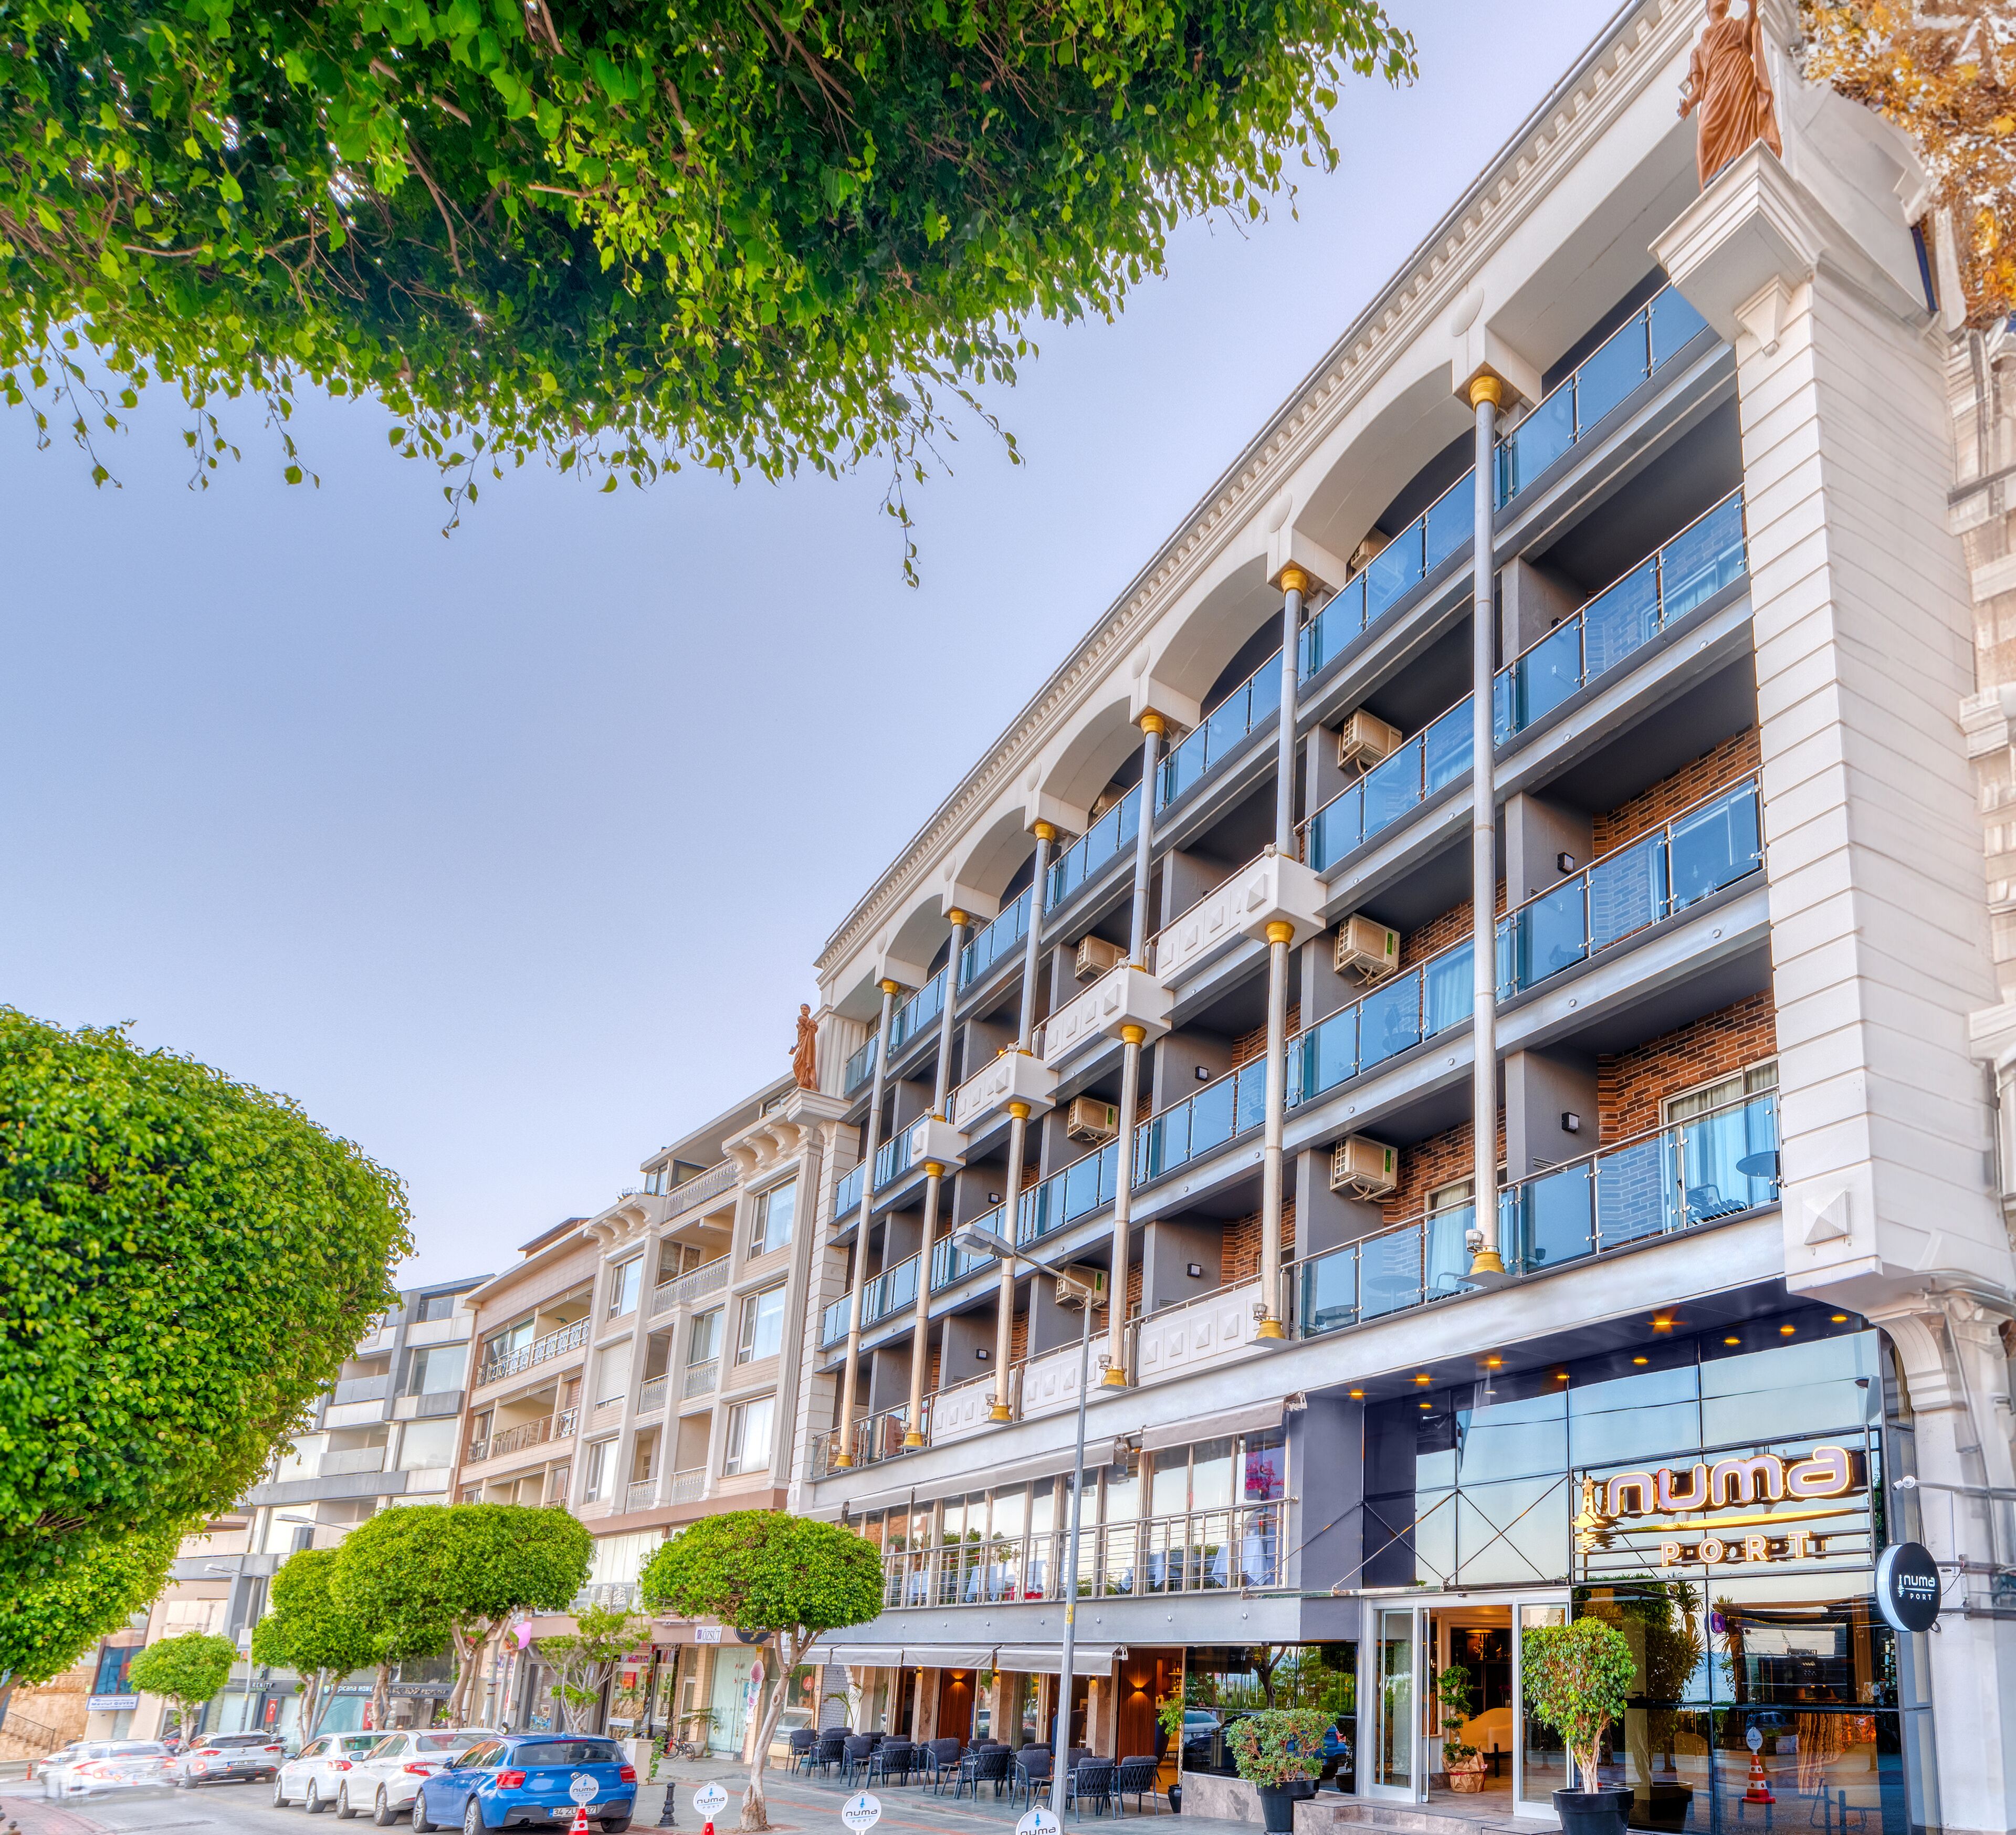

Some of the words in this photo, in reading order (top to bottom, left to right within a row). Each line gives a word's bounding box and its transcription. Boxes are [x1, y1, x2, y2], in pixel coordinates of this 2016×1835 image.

[1607, 1445, 1853, 1517] numa
[1661, 1530, 1811, 1567] PORT
[1904, 1575, 1936, 1587] numa
